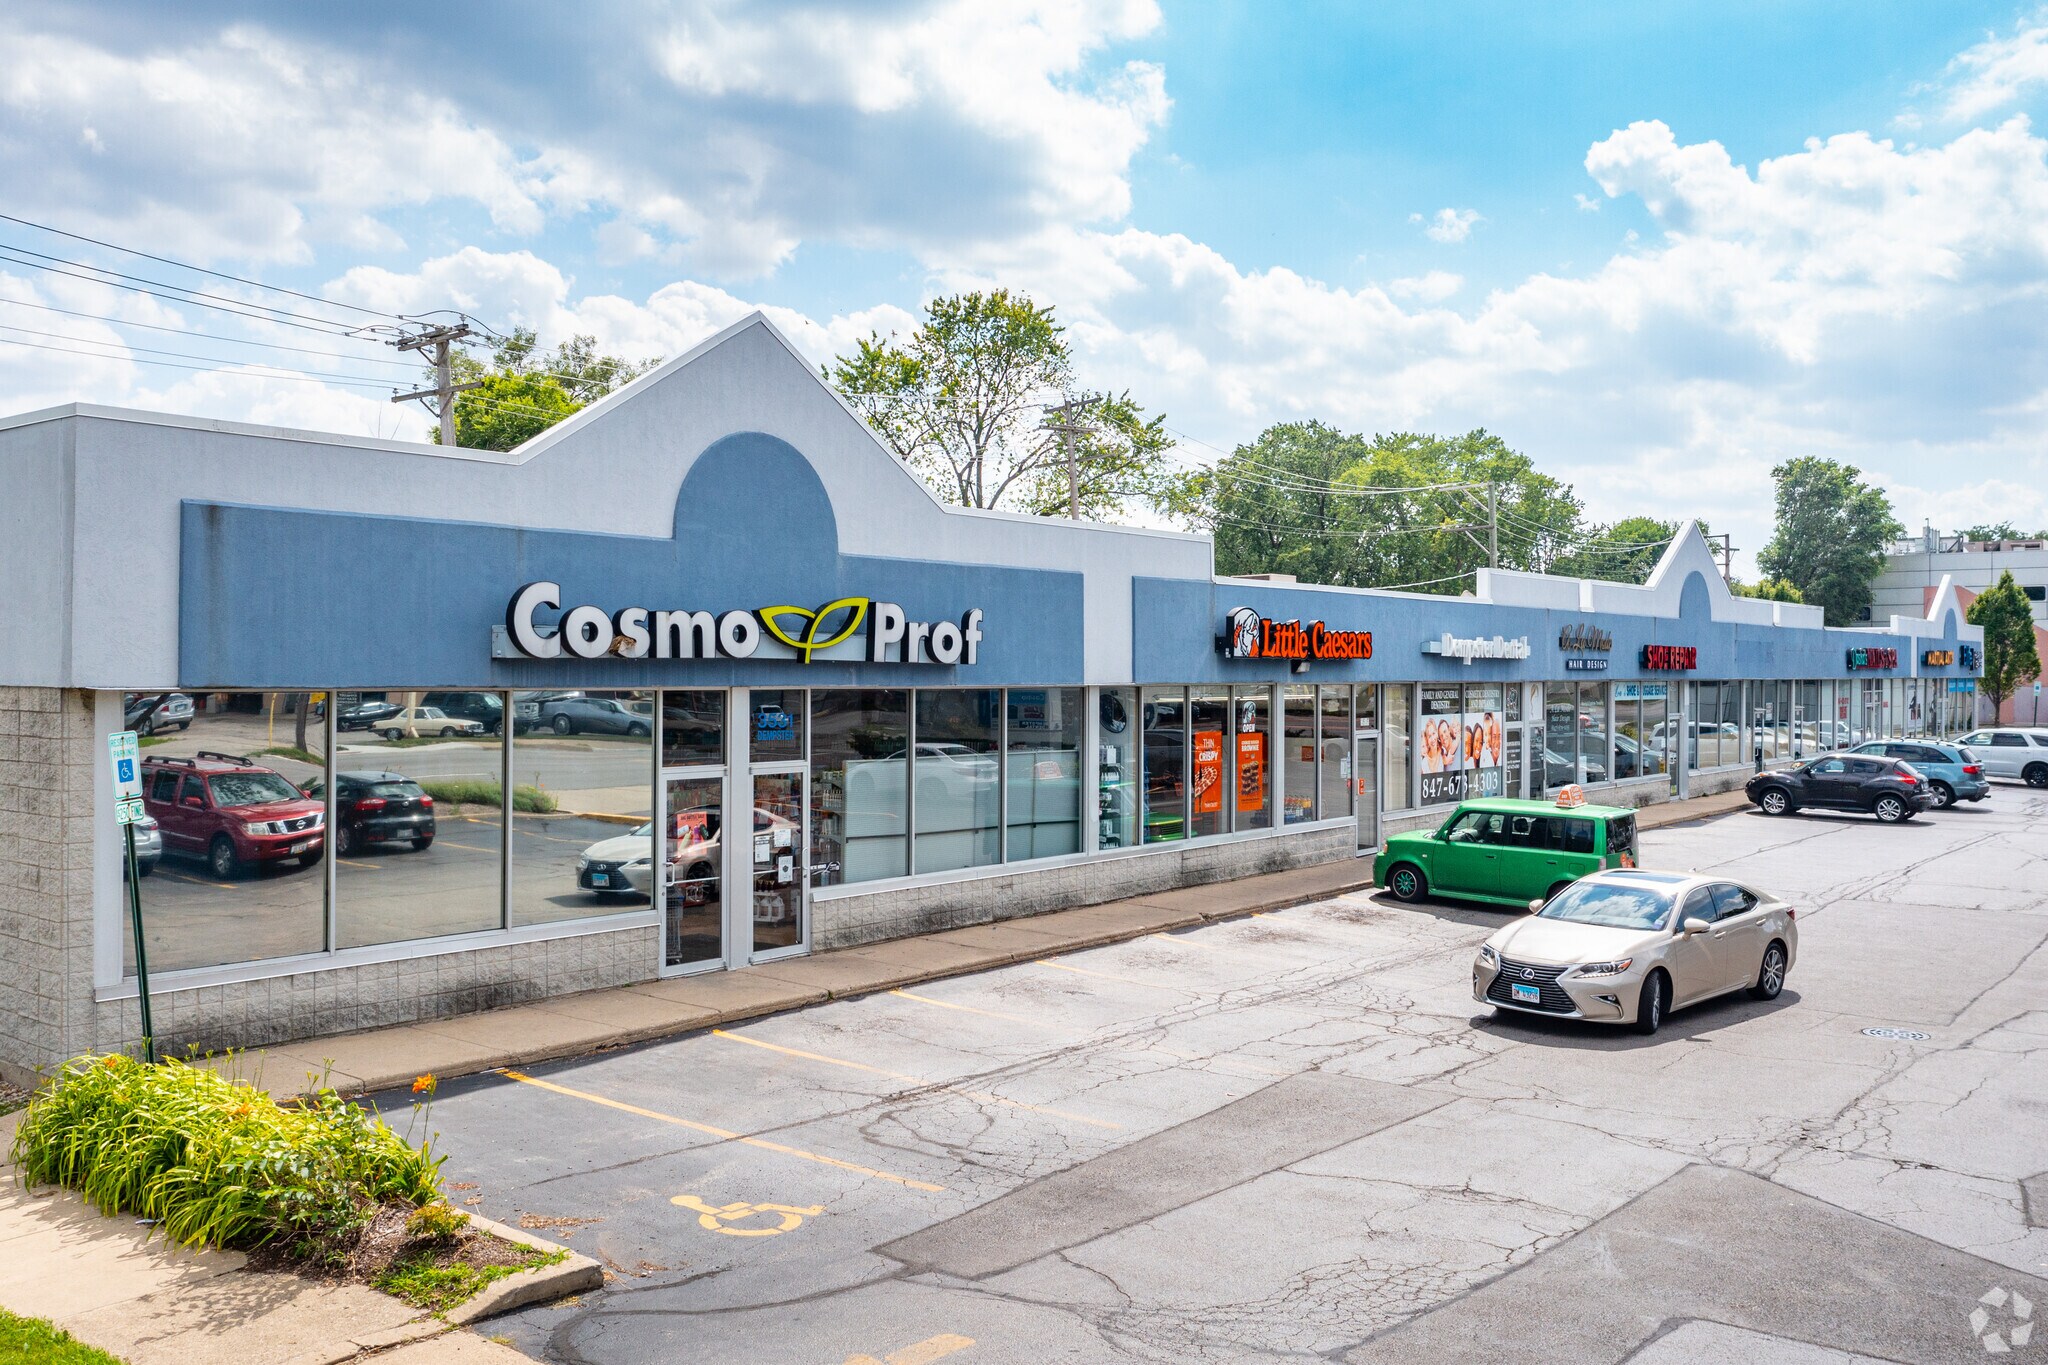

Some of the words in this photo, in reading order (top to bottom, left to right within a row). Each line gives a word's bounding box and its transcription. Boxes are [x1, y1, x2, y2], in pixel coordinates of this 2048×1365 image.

[507, 581, 761, 659] Cosmo
[867, 601, 983, 665] Prof
[1261, 618, 1309, 659] Little
[1311, 620, 1372, 660] Caesars
[1441, 633, 1493, 665] Dempster
[1493, 636, 1528, 659] Dental
[1568, 660, 1583, 669] HAIR
[1586, 660, 1607, 669] DESIGN
[1647, 645, 1669, 670] SHOE
[1670, 646, 1697, 670] REPAIR
[757, 713, 794, 729] 3531
[1242, 723, 1256, 733] OPEN
[757, 730, 794, 741] DEMPSTER
[1203, 738, 1215, 748] THIN
[1198, 750, 1219, 762] CRISPY
[1422, 771, 1498, 799] 847-673-4303
[131, 804, 143, 817] FINE
